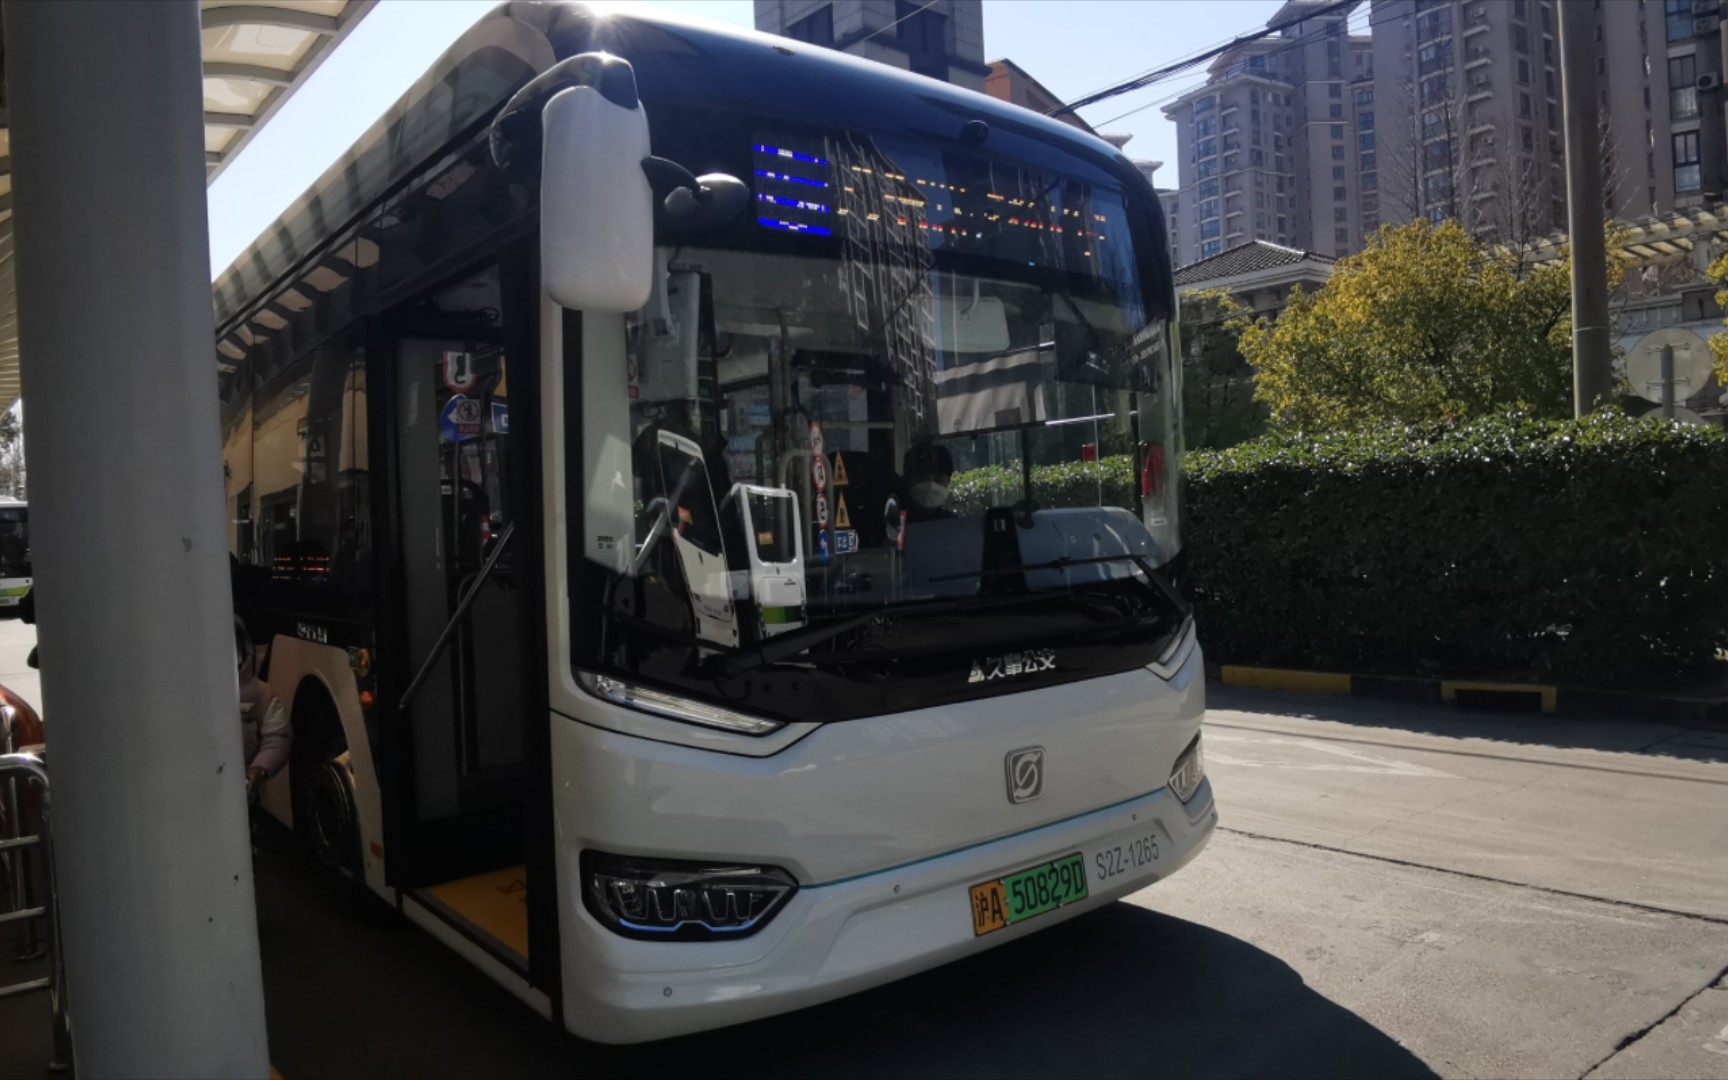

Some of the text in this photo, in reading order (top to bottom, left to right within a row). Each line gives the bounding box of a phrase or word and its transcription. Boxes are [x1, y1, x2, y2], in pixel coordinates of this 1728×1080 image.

[986, 648, 1056, 680] 久事公交
[1096, 834, 1159, 880] S2Z-1265
